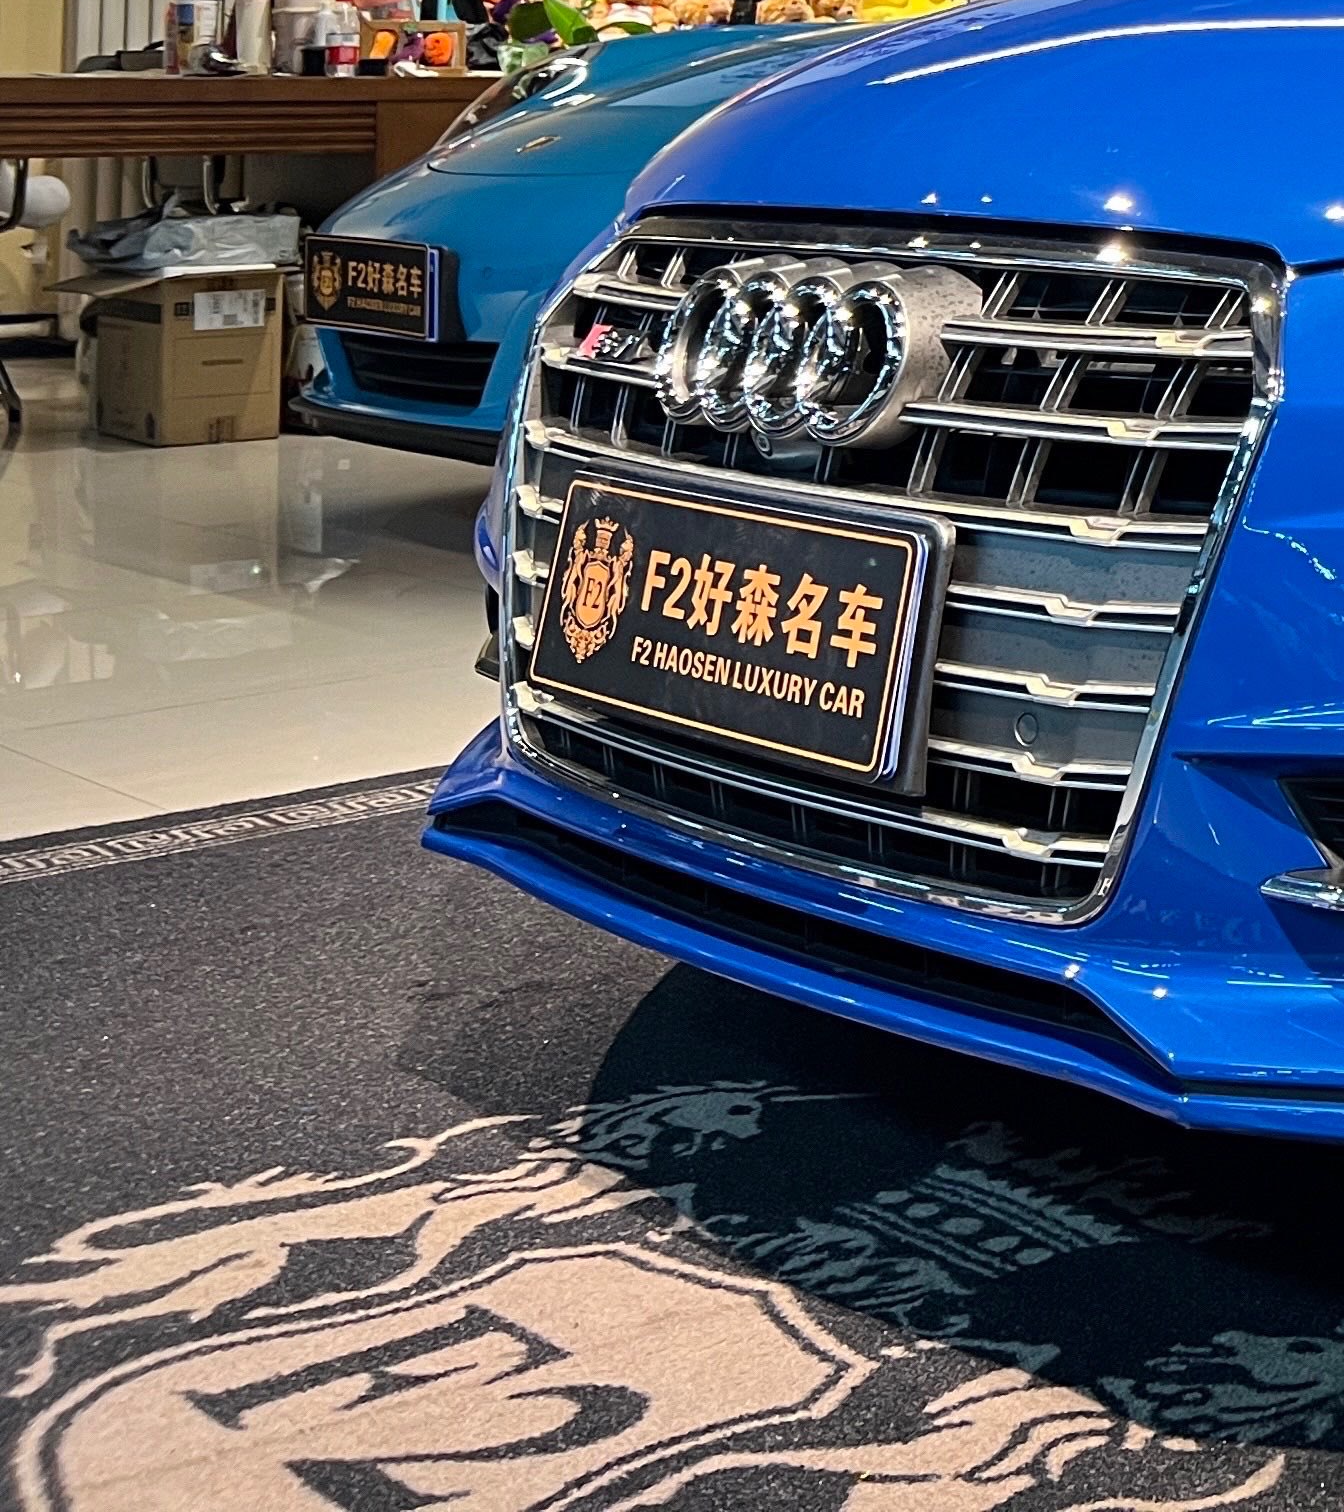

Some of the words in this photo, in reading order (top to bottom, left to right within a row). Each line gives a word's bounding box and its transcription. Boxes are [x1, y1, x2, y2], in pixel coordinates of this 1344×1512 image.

[641, 550, 883, 668] F2好森名车
[631, 636, 652, 667] F2
[653, 642, 732, 686] HAOSEN
[733, 664, 818, 706] LUXURY
[819, 681, 865, 718] CAR
